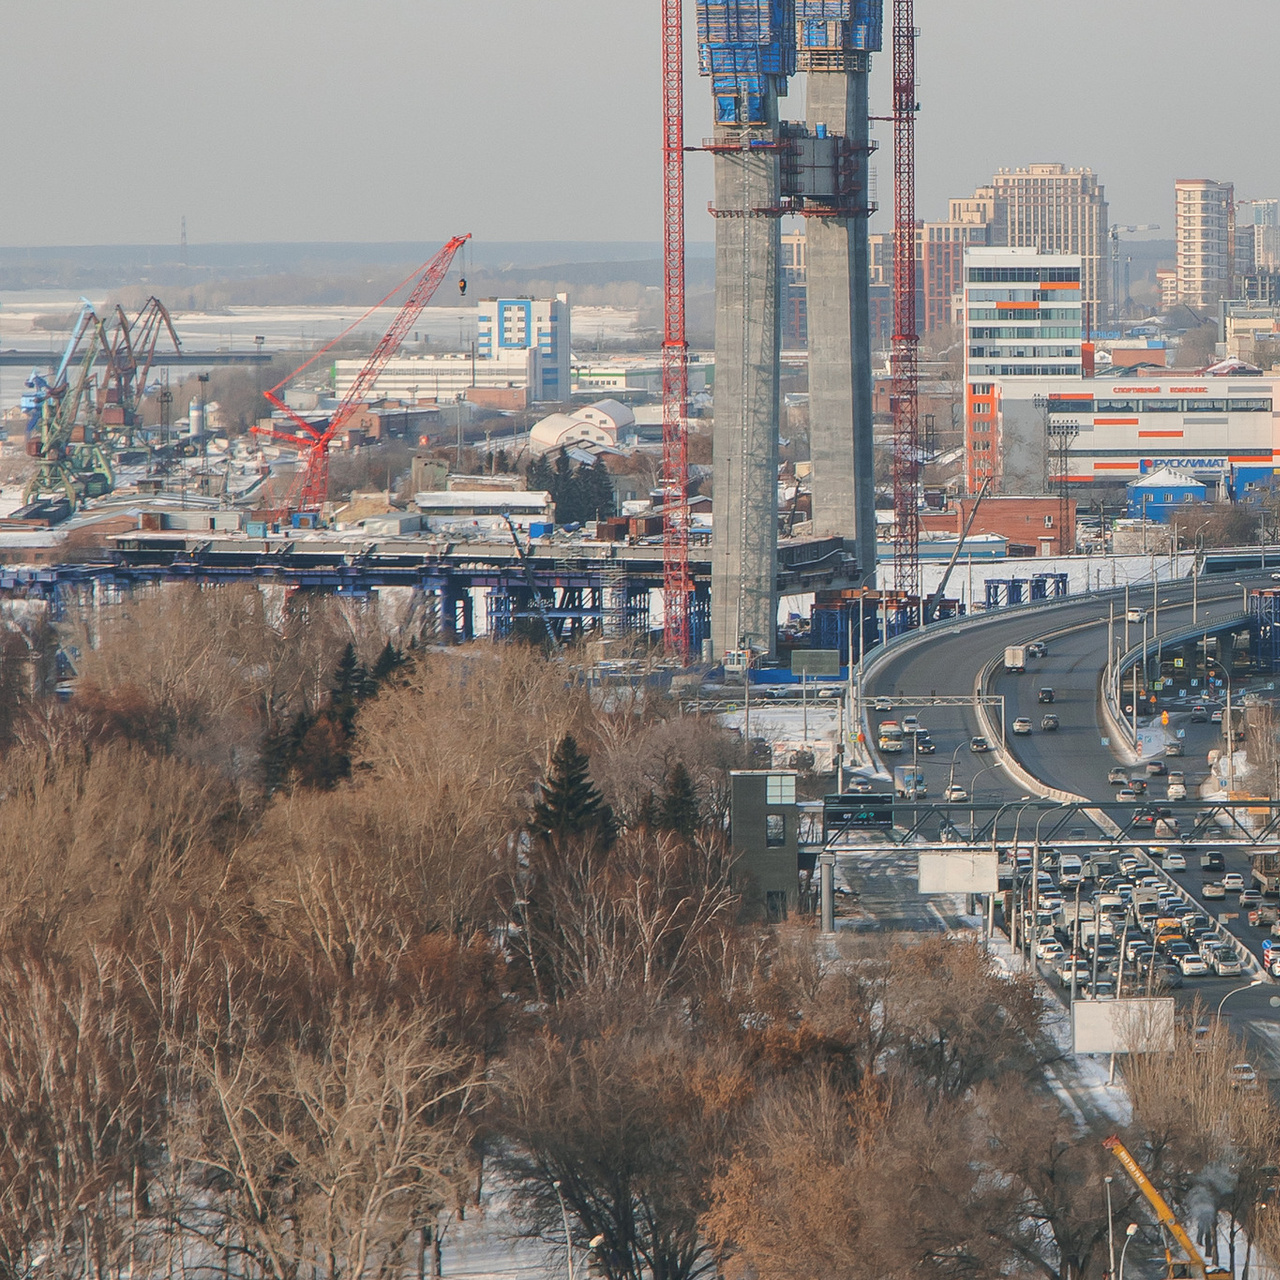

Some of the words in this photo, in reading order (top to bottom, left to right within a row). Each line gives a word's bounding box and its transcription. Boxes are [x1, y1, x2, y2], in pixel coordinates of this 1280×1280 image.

[1112, 385, 1161, 394] СПОРТИВНЫЙ
[1169, 386, 1209, 394] КОМПЛЕКС
[1153, 458, 1228, 469] РУСКЛИМАТ
